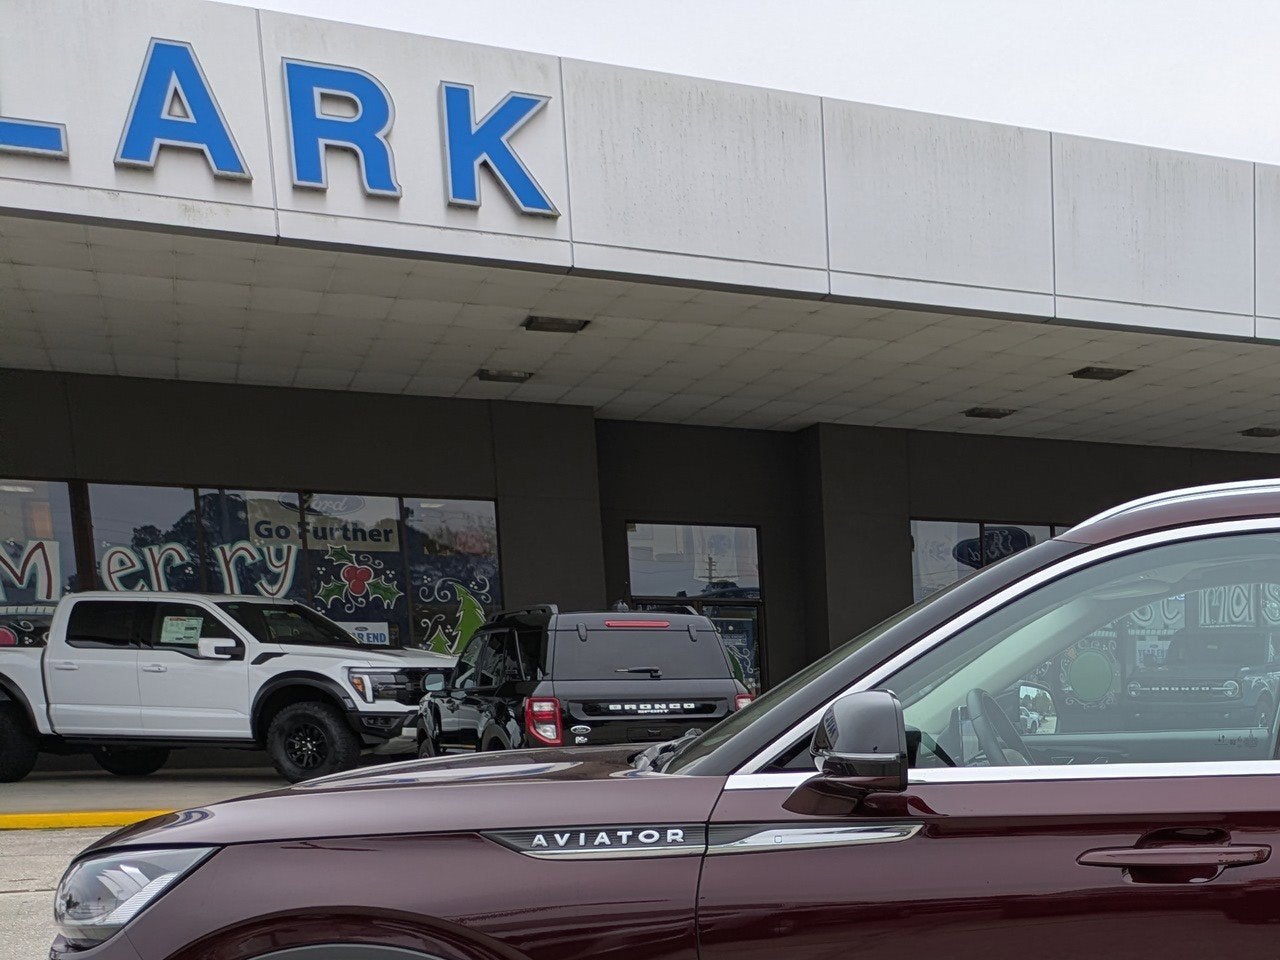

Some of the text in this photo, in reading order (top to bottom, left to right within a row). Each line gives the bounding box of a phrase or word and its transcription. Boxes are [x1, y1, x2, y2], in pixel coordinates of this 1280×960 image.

[254, 519, 394, 543] Go Further
[366, 632, 387, 643] END
[608, 703, 696, 711] BRONCO
[530, 828, 685, 849] AVIATOR
